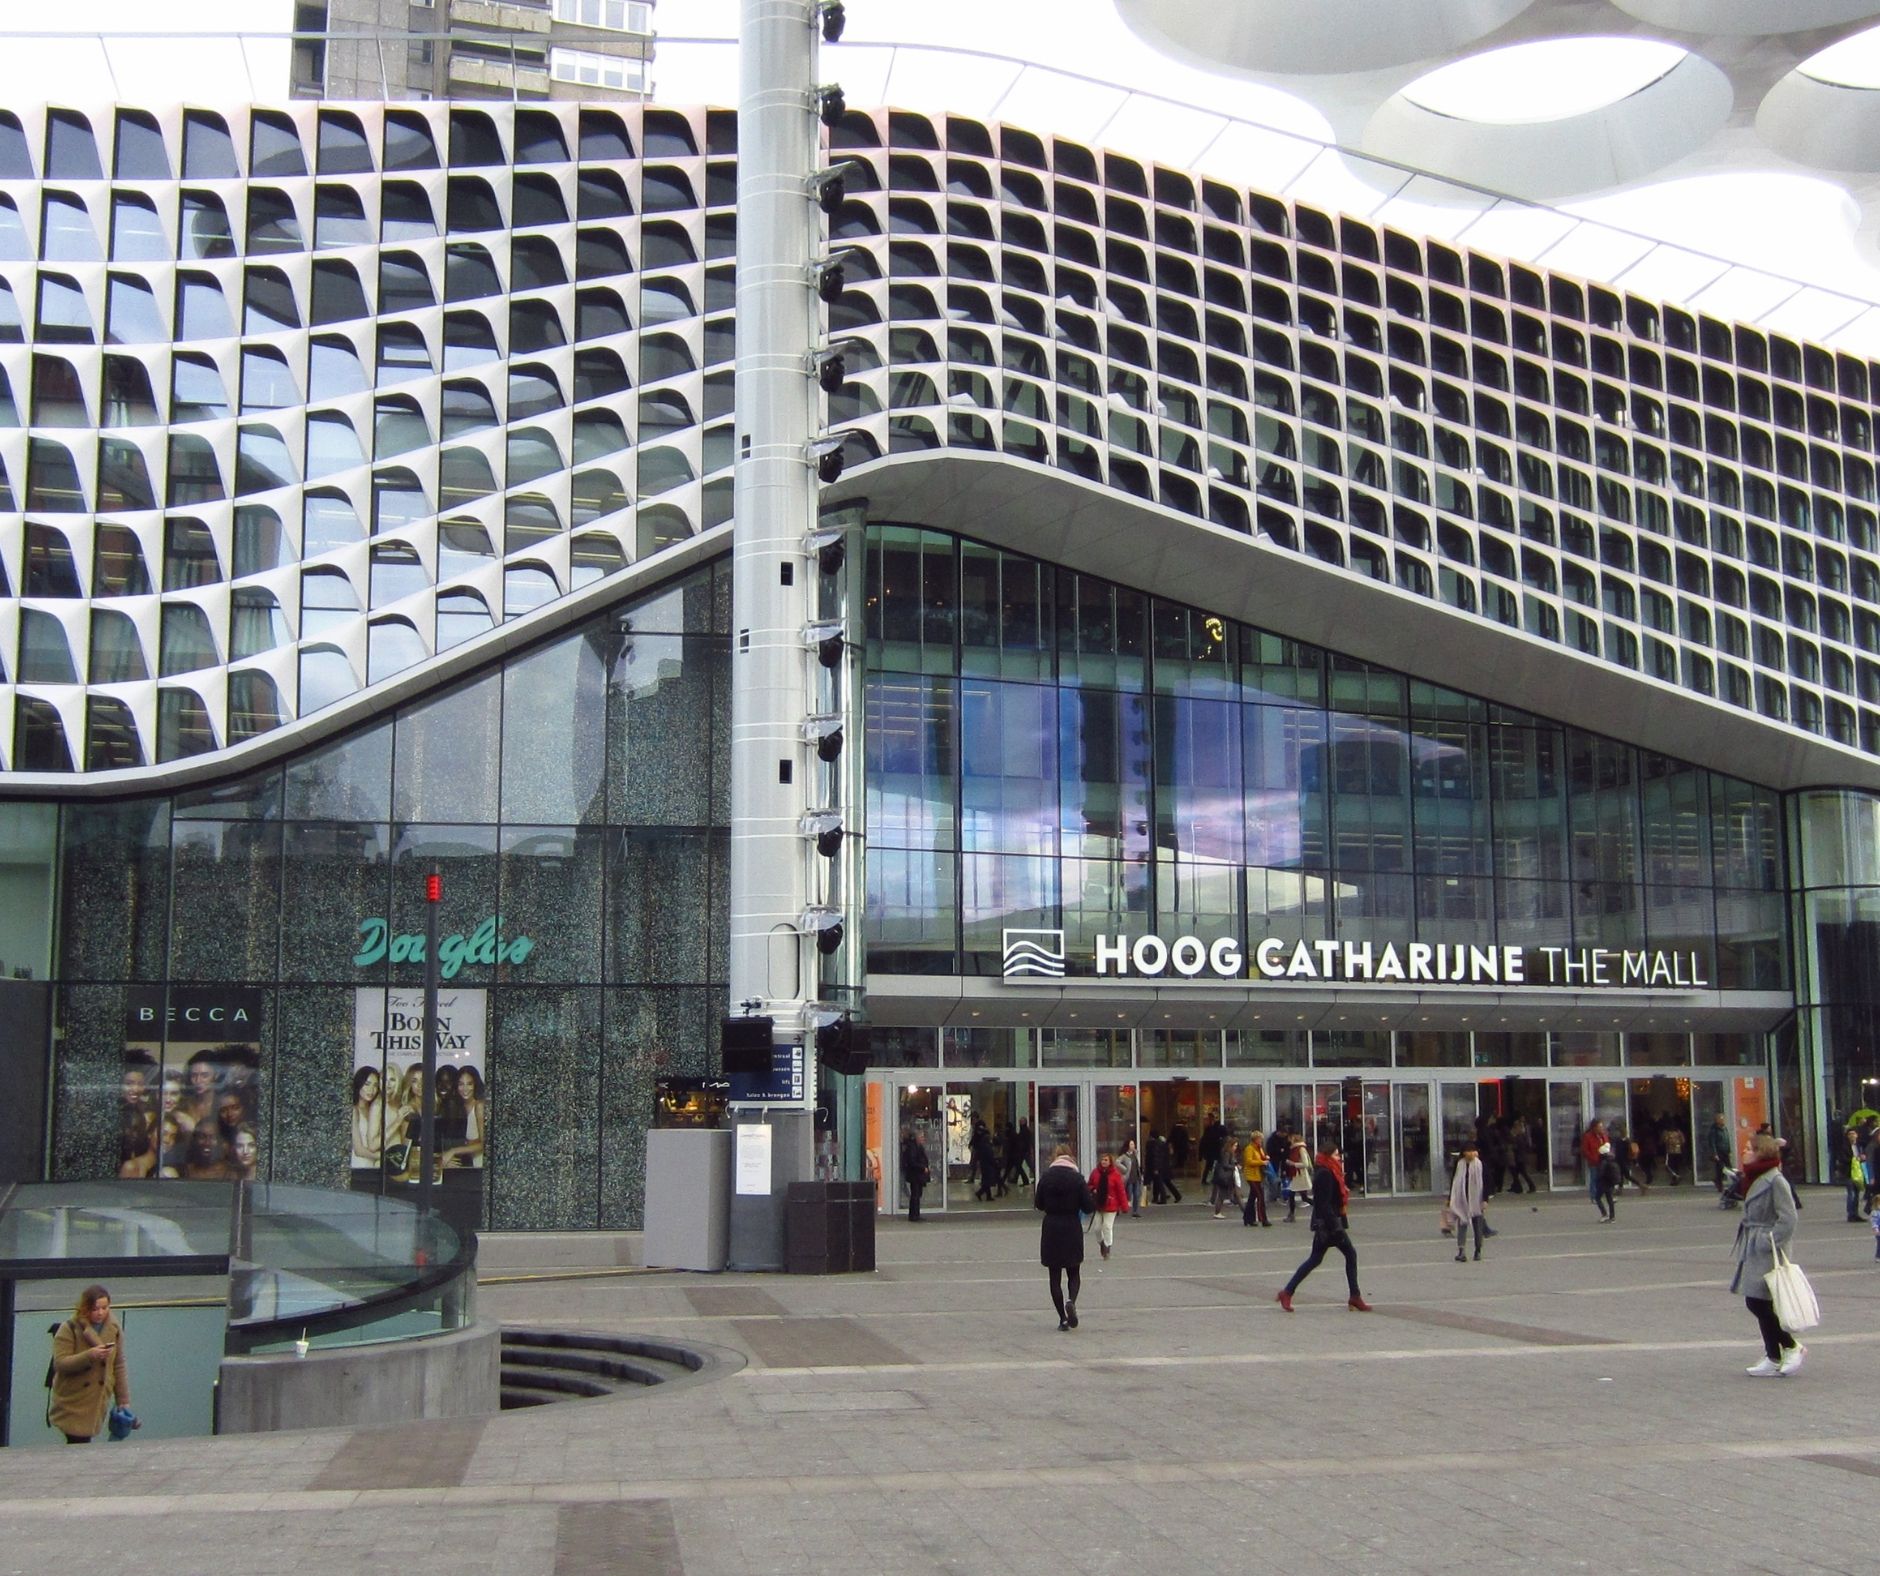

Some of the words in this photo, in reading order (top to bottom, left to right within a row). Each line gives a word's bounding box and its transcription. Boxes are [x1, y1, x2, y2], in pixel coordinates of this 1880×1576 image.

[352, 916, 536, 979] Douglas
[1096, 934, 1242, 976] HOOG
[1256, 937, 1525, 982] CATHARIJNE
[1539, 947, 1611, 984] THE
[1622, 949, 1708, 985] MALL
[140, 1007, 249, 1022] BECCA
[370, 1031, 421, 1050] THIS
